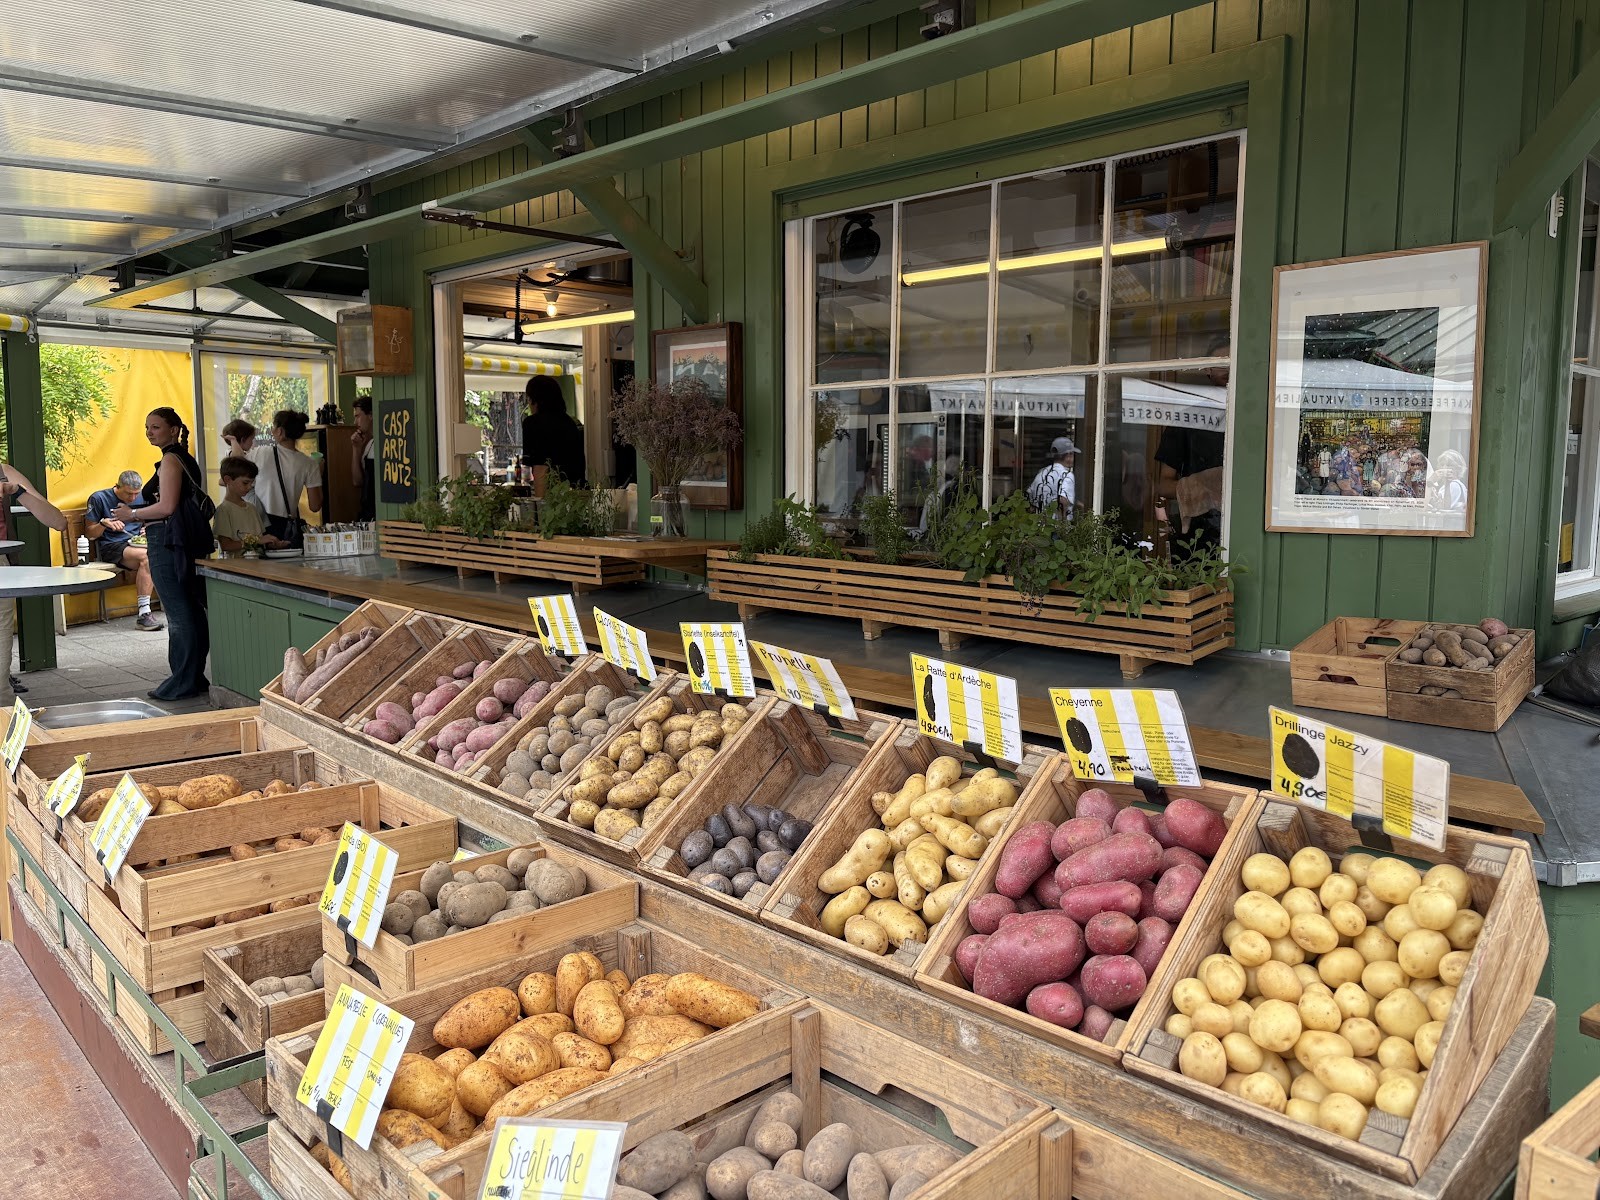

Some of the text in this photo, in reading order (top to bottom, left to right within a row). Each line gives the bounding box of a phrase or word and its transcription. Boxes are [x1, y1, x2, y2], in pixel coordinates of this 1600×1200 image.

[382, 409, 410, 438] CASP
[382, 437, 411, 465] ARPL
[759, 647, 817, 674] Prunelle
[914, 661, 992, 690] La Ratte d'Ardèche
[1055, 696, 1103, 708] Cheyenne
[1275, 715, 1369, 756] Drillinge Jazzy
[1078, 759, 1106, 778] 4,90
[1281, 777, 1328, 801] 4,90€
[355, 838, 367, 854] (BIO)
[499, 1136, 585, 1189] Sieglinde
